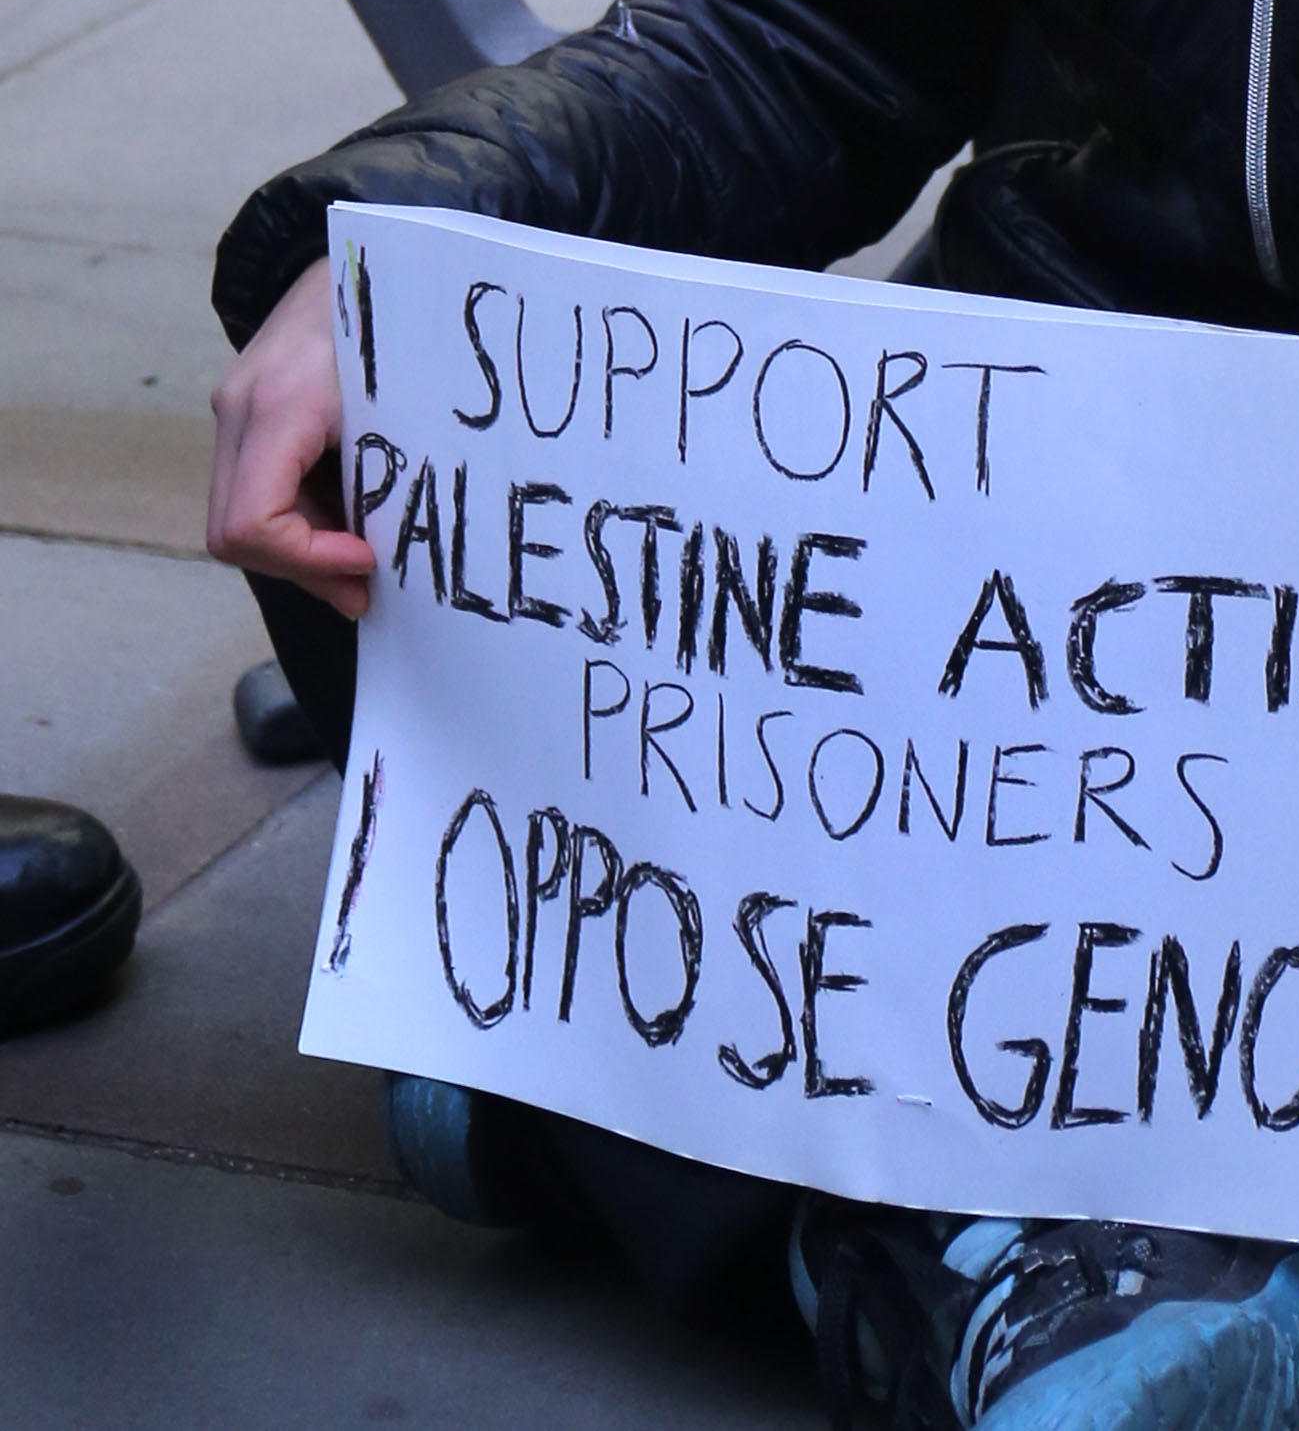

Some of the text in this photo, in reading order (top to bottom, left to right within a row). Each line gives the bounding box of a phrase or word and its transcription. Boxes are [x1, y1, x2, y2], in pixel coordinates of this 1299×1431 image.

[452, 281, 1049, 503] SUPPORT
[352, 432, 868, 696] PALESTINE
[583, 658, 1228, 881] PRISONERS
[434, 786, 876, 1100] OPPOSE
